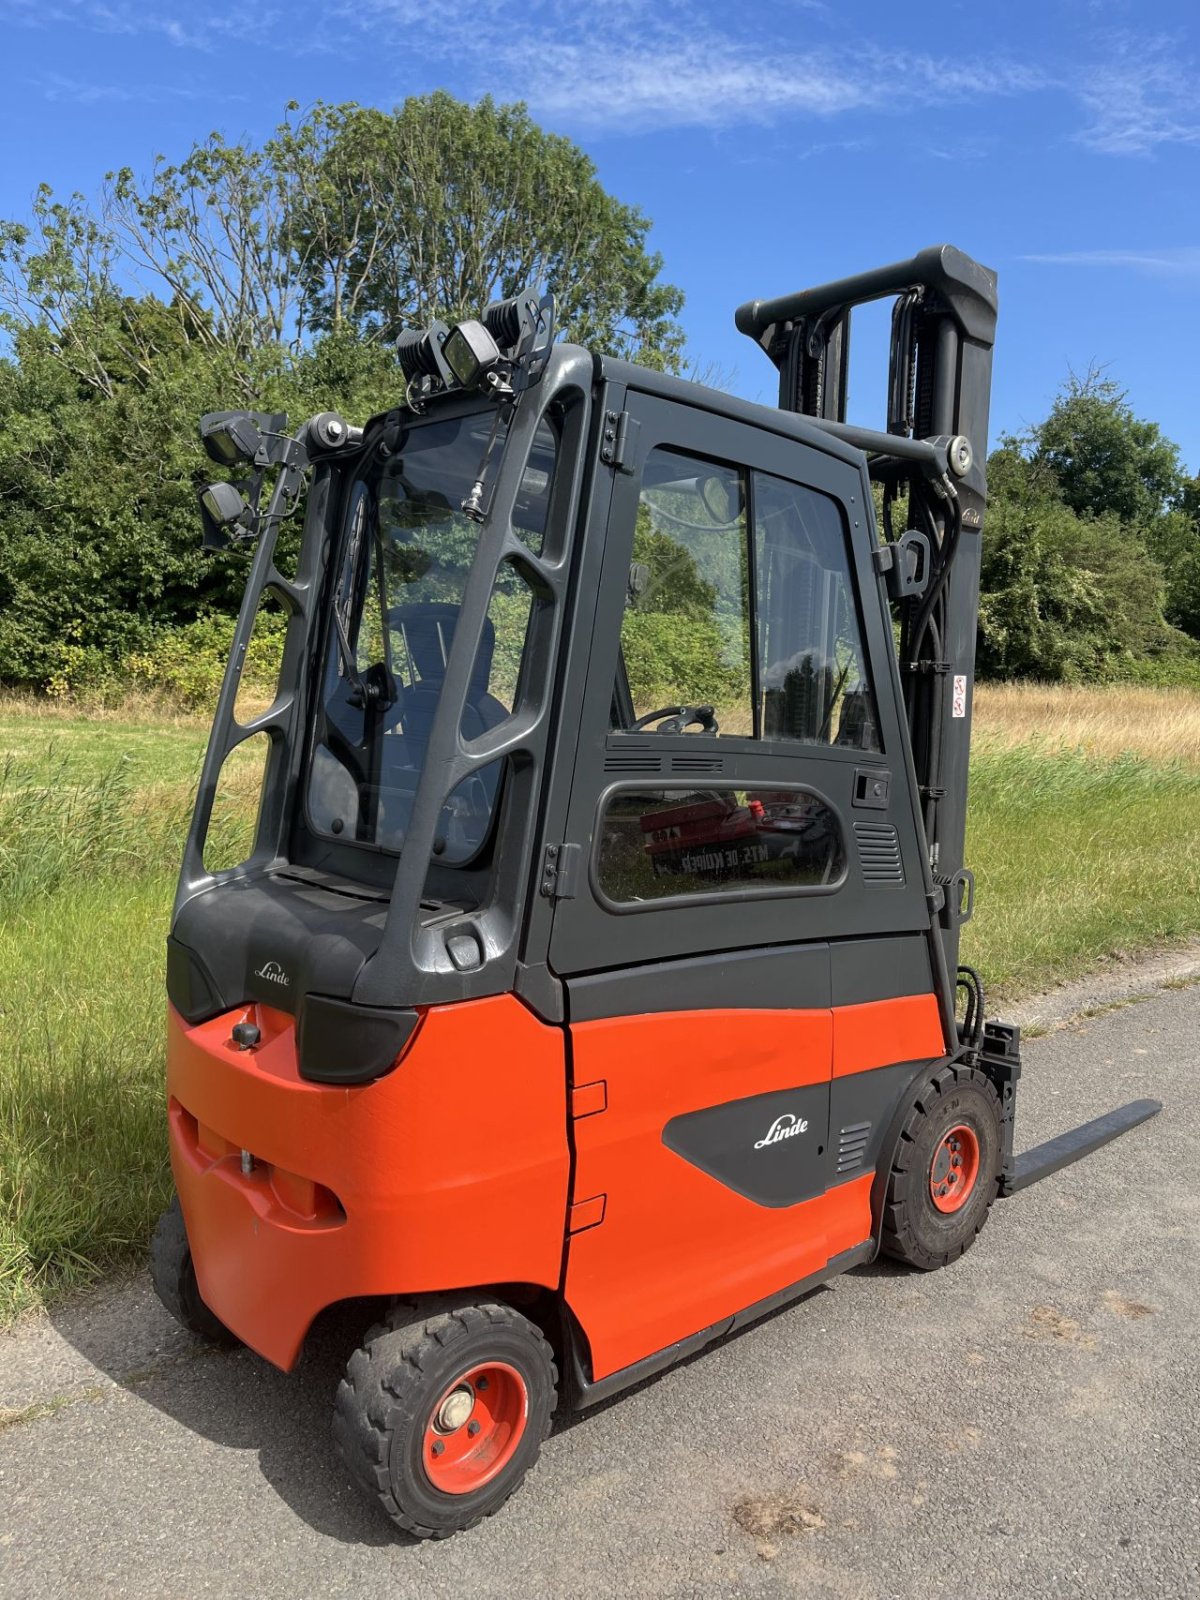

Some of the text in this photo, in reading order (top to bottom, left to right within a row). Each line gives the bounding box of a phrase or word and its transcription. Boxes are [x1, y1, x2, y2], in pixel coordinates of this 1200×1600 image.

[961, 508, 980, 524] Lind
[254, 961, 290, 986] Linde
[754, 1113, 808, 1149] Linde
